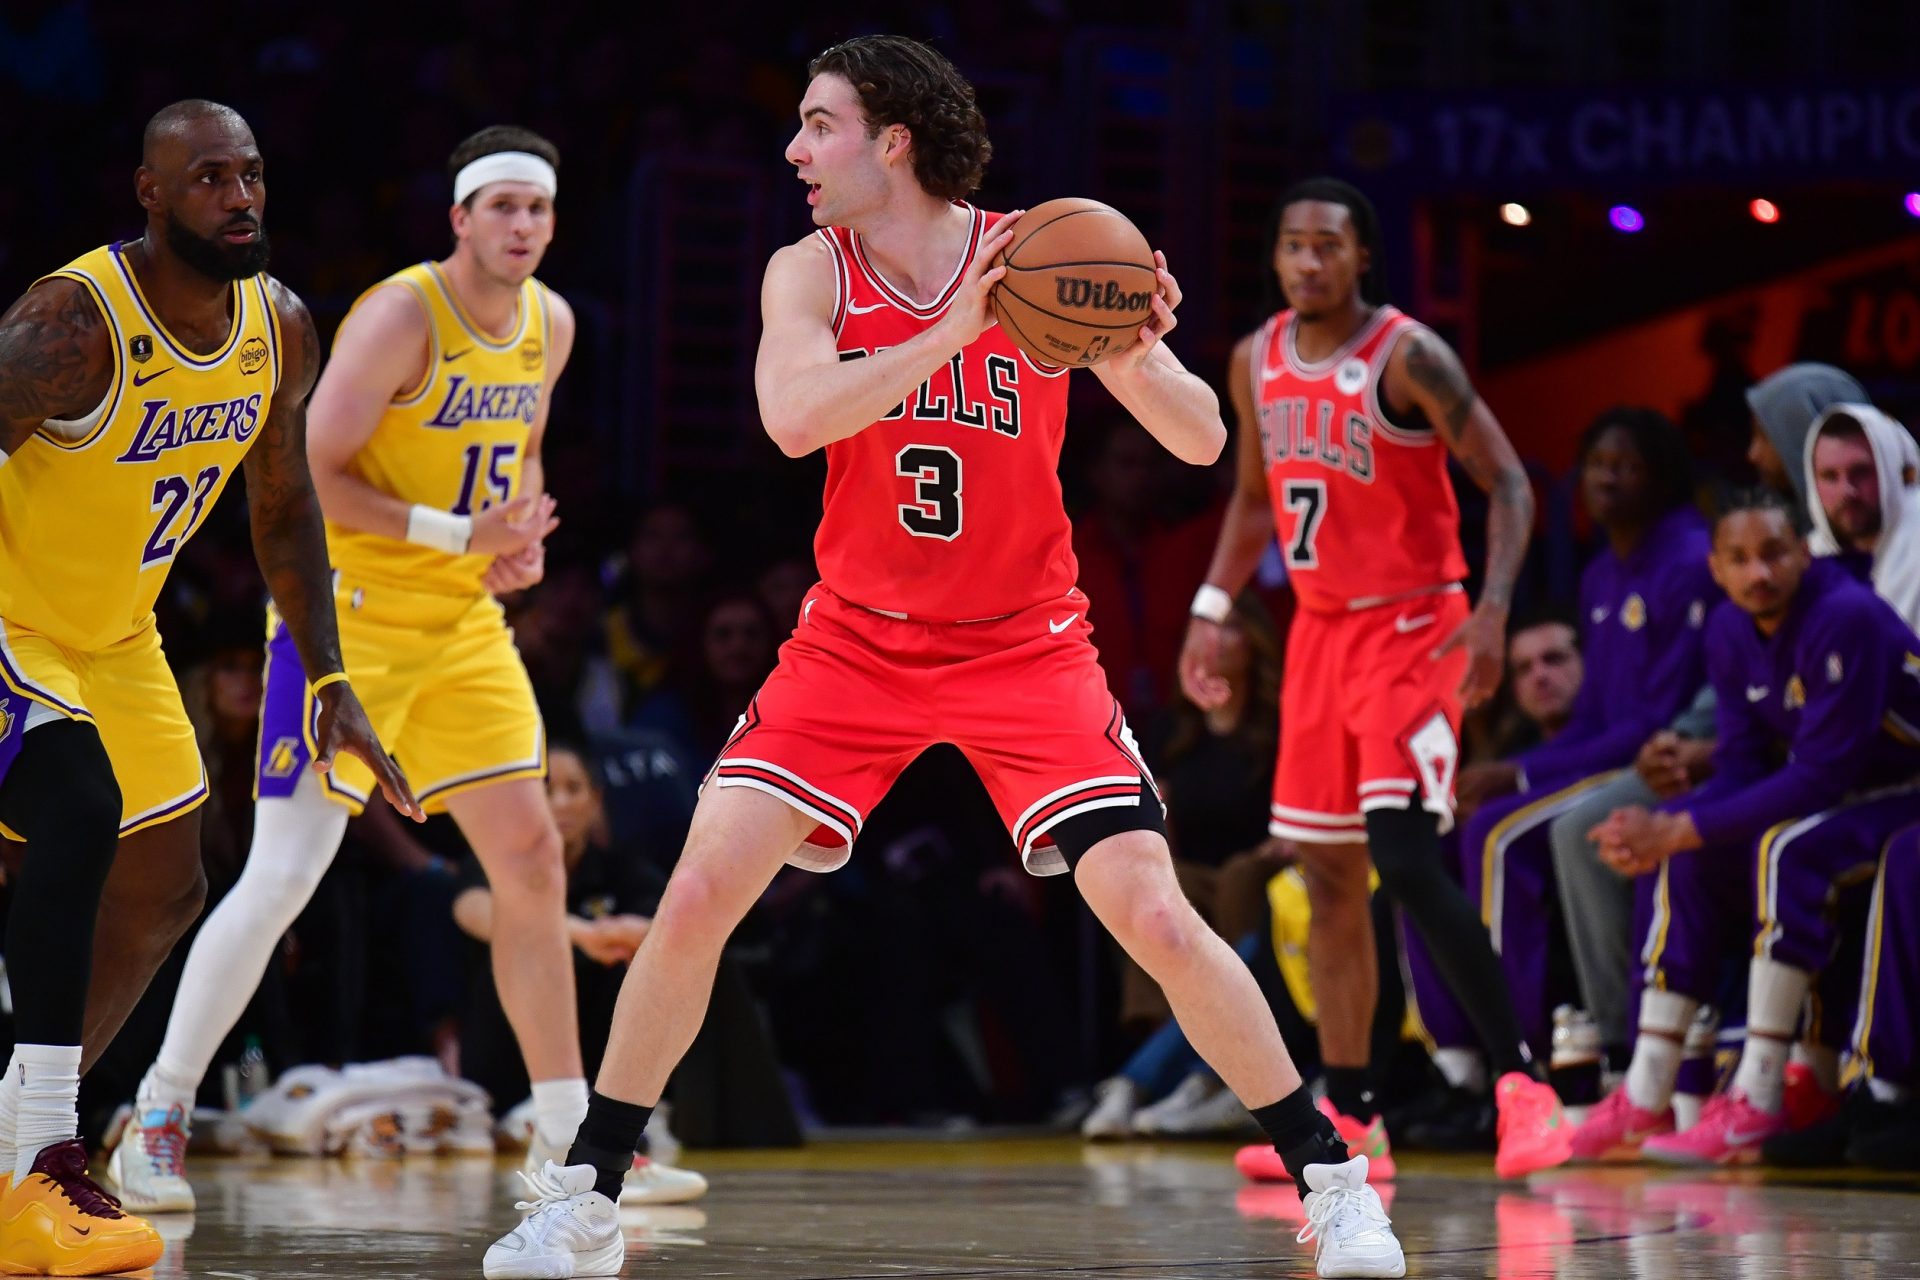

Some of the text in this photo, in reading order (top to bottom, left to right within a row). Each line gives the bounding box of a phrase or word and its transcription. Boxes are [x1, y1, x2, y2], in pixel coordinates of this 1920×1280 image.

[1055, 276, 1152, 312] Wilson
[115, 393, 263, 463] LAKERS
[422, 376, 541, 430] LAKERS
[450, 441, 517, 516] 15
[895, 443, 963, 542] 3
[1282, 478, 1328, 570] 7
